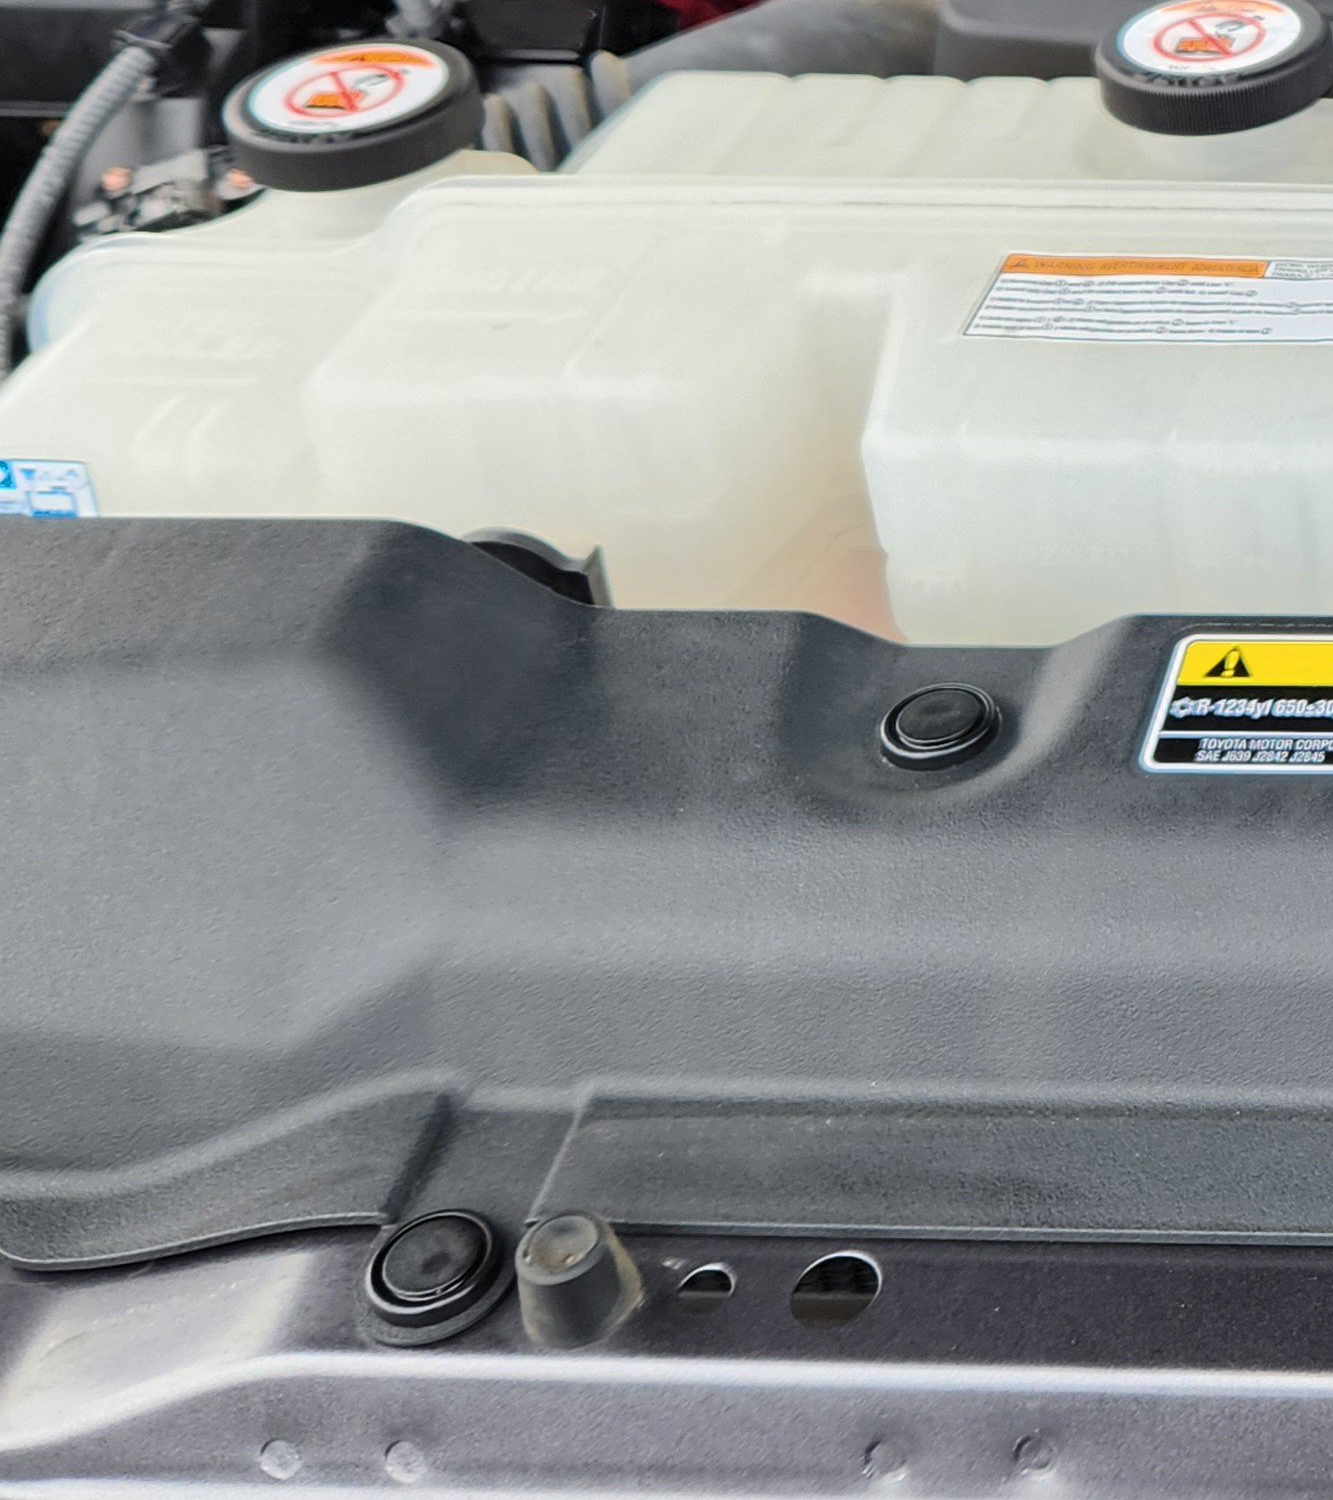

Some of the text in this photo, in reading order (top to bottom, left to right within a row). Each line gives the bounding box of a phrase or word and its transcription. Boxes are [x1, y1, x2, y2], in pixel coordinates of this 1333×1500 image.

[1199, 738, 1247, 750] TOYOTA
[1249, 739, 1293, 751] MOTOR
[1196, 750, 1325, 763] SAE J639 J2842 J2845
